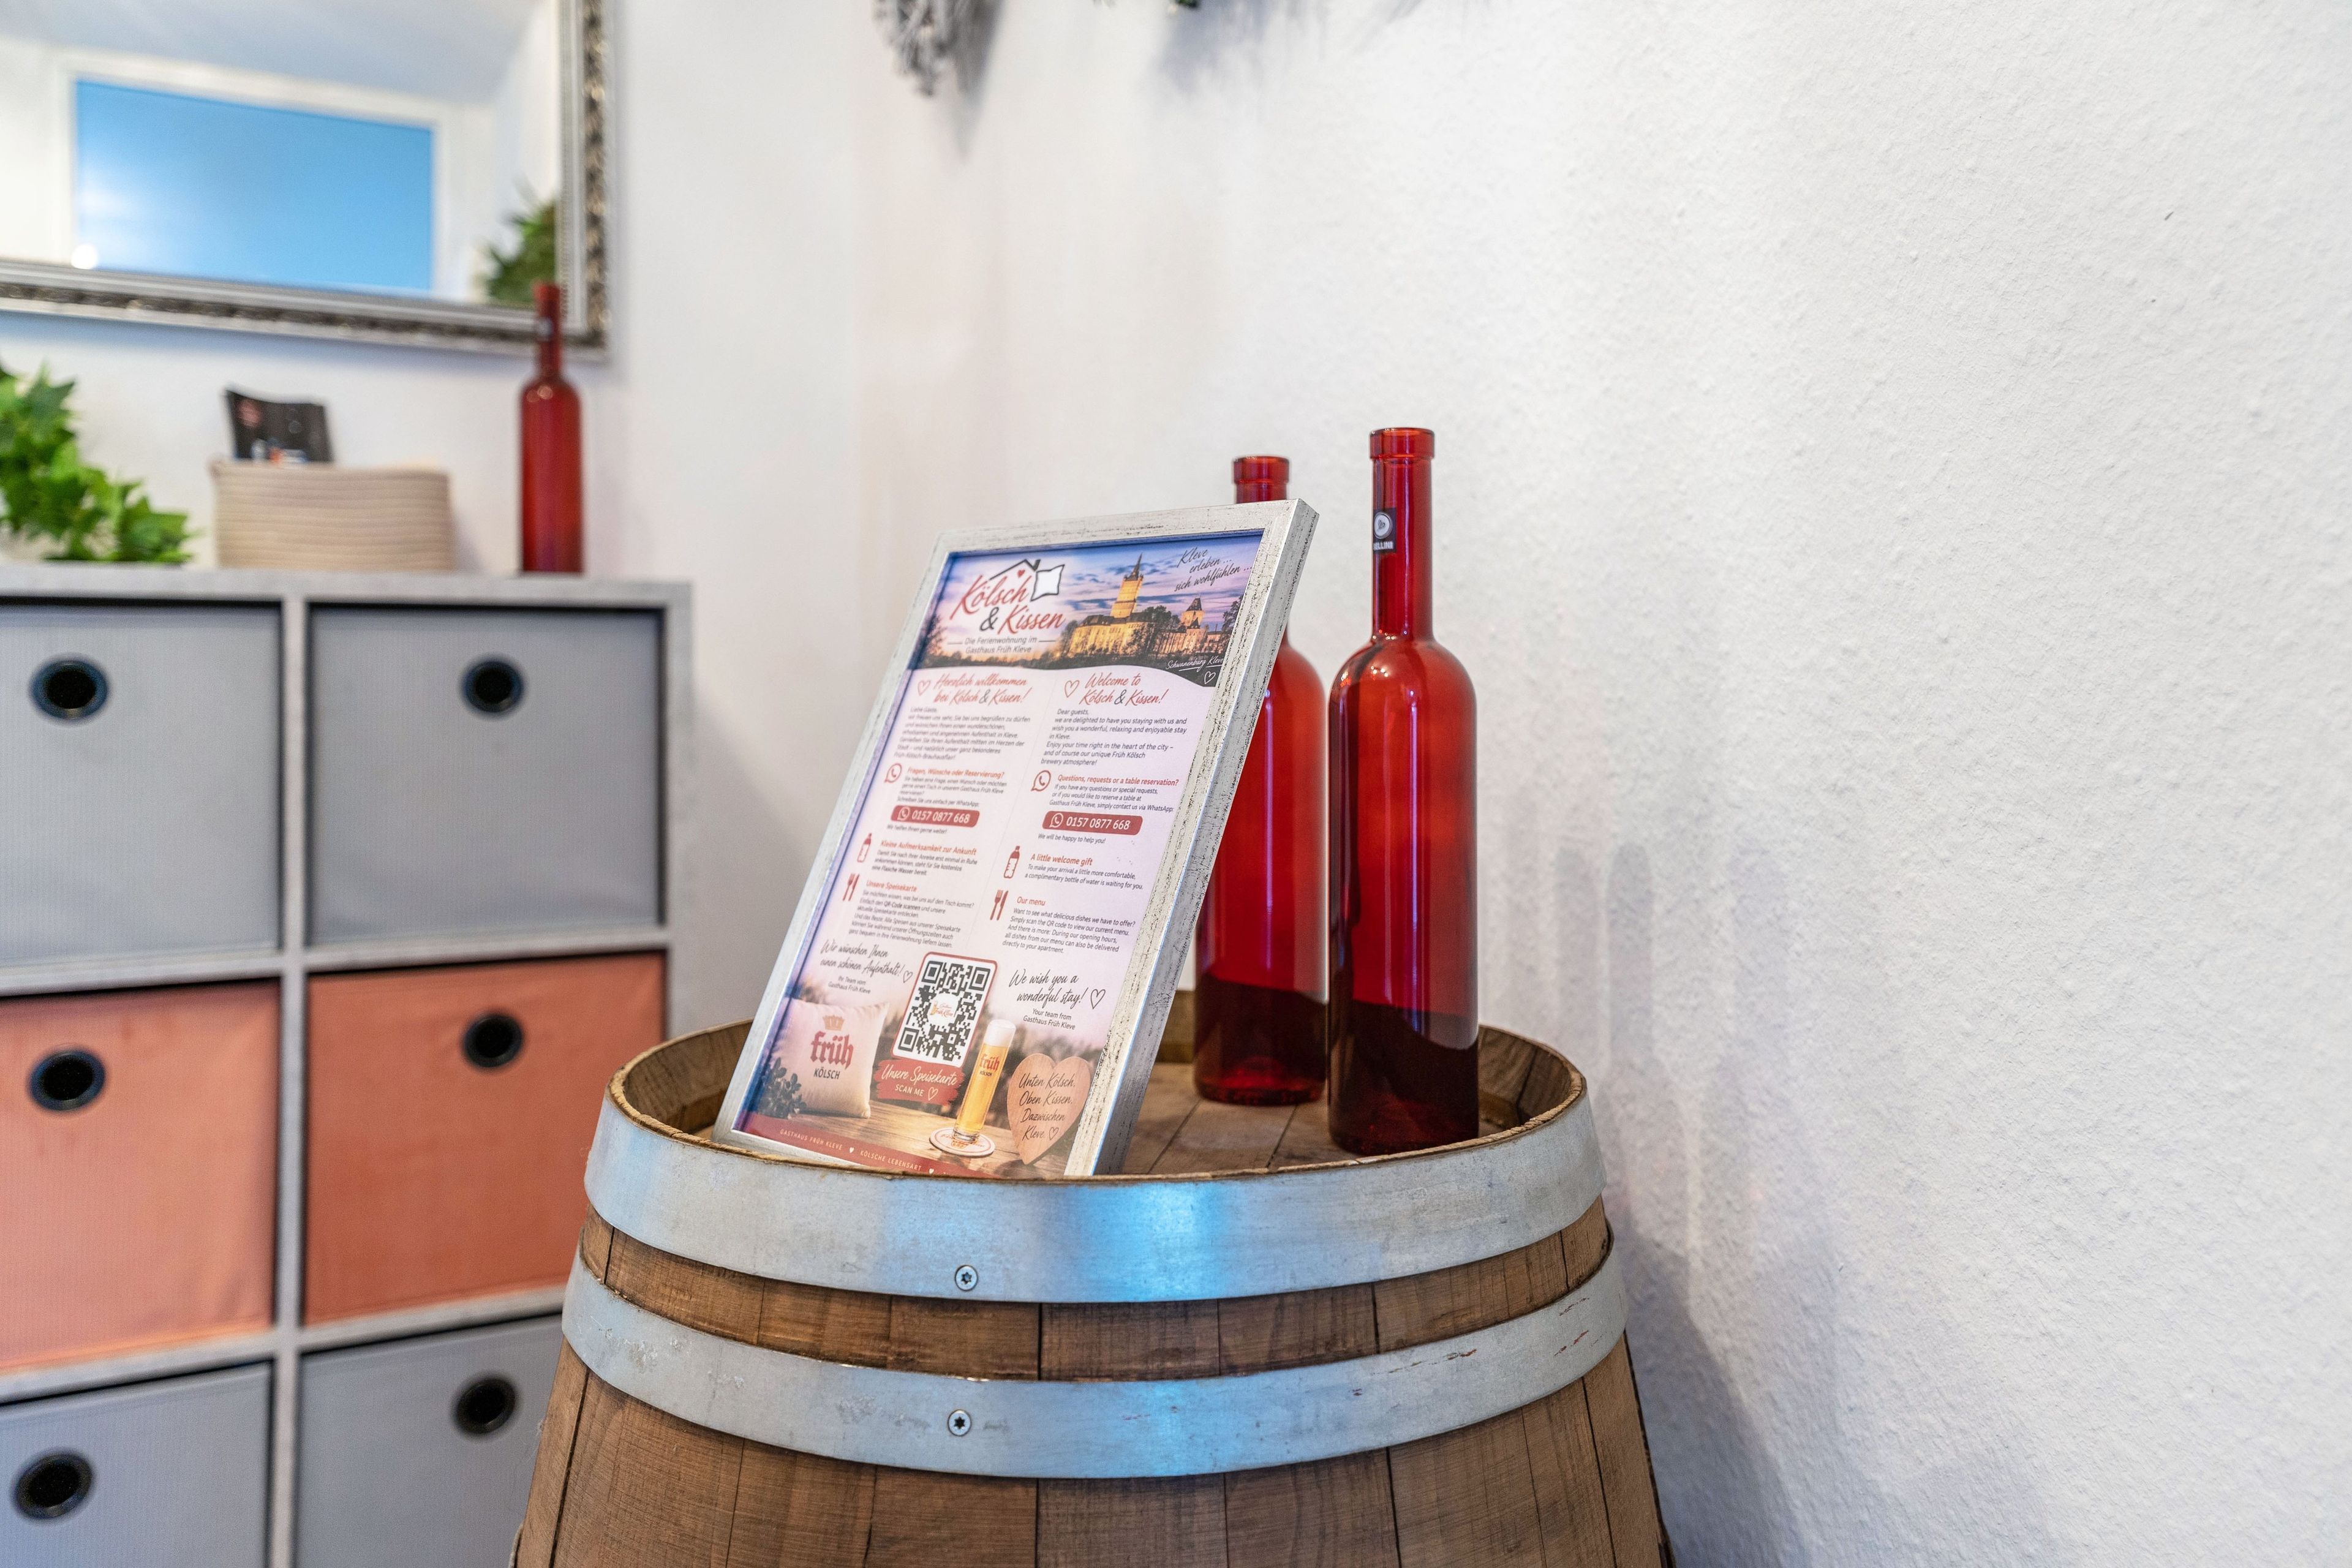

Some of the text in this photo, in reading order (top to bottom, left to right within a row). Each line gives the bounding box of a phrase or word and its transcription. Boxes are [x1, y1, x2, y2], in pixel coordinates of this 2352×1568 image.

[1177, 547, 1208, 568] Kleve
[1189, 556, 1221, 574] erleben
[1174, 575, 1192, 592] sich
[1194, 562, 1240, 586] wohlfühlen
[949, 575, 1032, 620] Kölsch
[979, 605, 1067, 635] & Kissen
[965, 644, 1032, 655] Gasthaus Früh Kleve
[1165, 655, 1224, 673] Schwanenburg Klev
[933, 673, 1027, 690] Herzlich willkommen
[1085, 673, 1141, 688] Welcome to
[933, 690, 949, 703] bei
[979, 689, 990, 704] &
[988, 687, 1033, 706] Kissen!
[1079, 688, 1169, 706] Kölsch & Kissen!
[1157, 744, 1169, 752] city
[1058, 774, 1085, 783] Questions,
[911, 810, 970, 824] 0157 0877 668
[1066, 816, 1131, 830] 0157 0877 668
[1052, 856, 1080, 865] welcome
[1080, 858, 1093, 867] gift
[1028, 873, 1065, 883] complimentary
[1106, 880, 1125, 889] waiting
[1010, 916, 1026, 924] Simply
[820, 939, 838, 954] Wir
[867, 944, 888, 958] Ihnen
[861, 960, 905, 978] Aufenthalt!
[1009, 968, 1079, 990] We wish you a
[1017, 987, 1089, 1009] wonderful stay!
[1022, 1015, 1047, 1025] Gasthaus
[1060, 1022, 1076, 1030] Kleve
[810, 1031, 854, 1069] früh
[979, 1054, 1000, 1072] früh
[813, 1068, 840, 1080] KÖLSCH
[881, 1063, 957, 1087] Unsere Speisekarte
[1019, 1072, 1076, 1088] Unten Kölsch.
[895, 1084, 924, 1097] SCAN ME
[1019, 1090, 1073, 1107] Oben Kissen.
[1020, 1107, 1066, 1123] Dazwischen
[780, 1127, 843, 1152] GASTHAUS FRÜH KLEVE
[1022, 1125, 1046, 1141] Kleve.
[859, 1150, 922, 1174] KÖLSCHE LEBENSART
